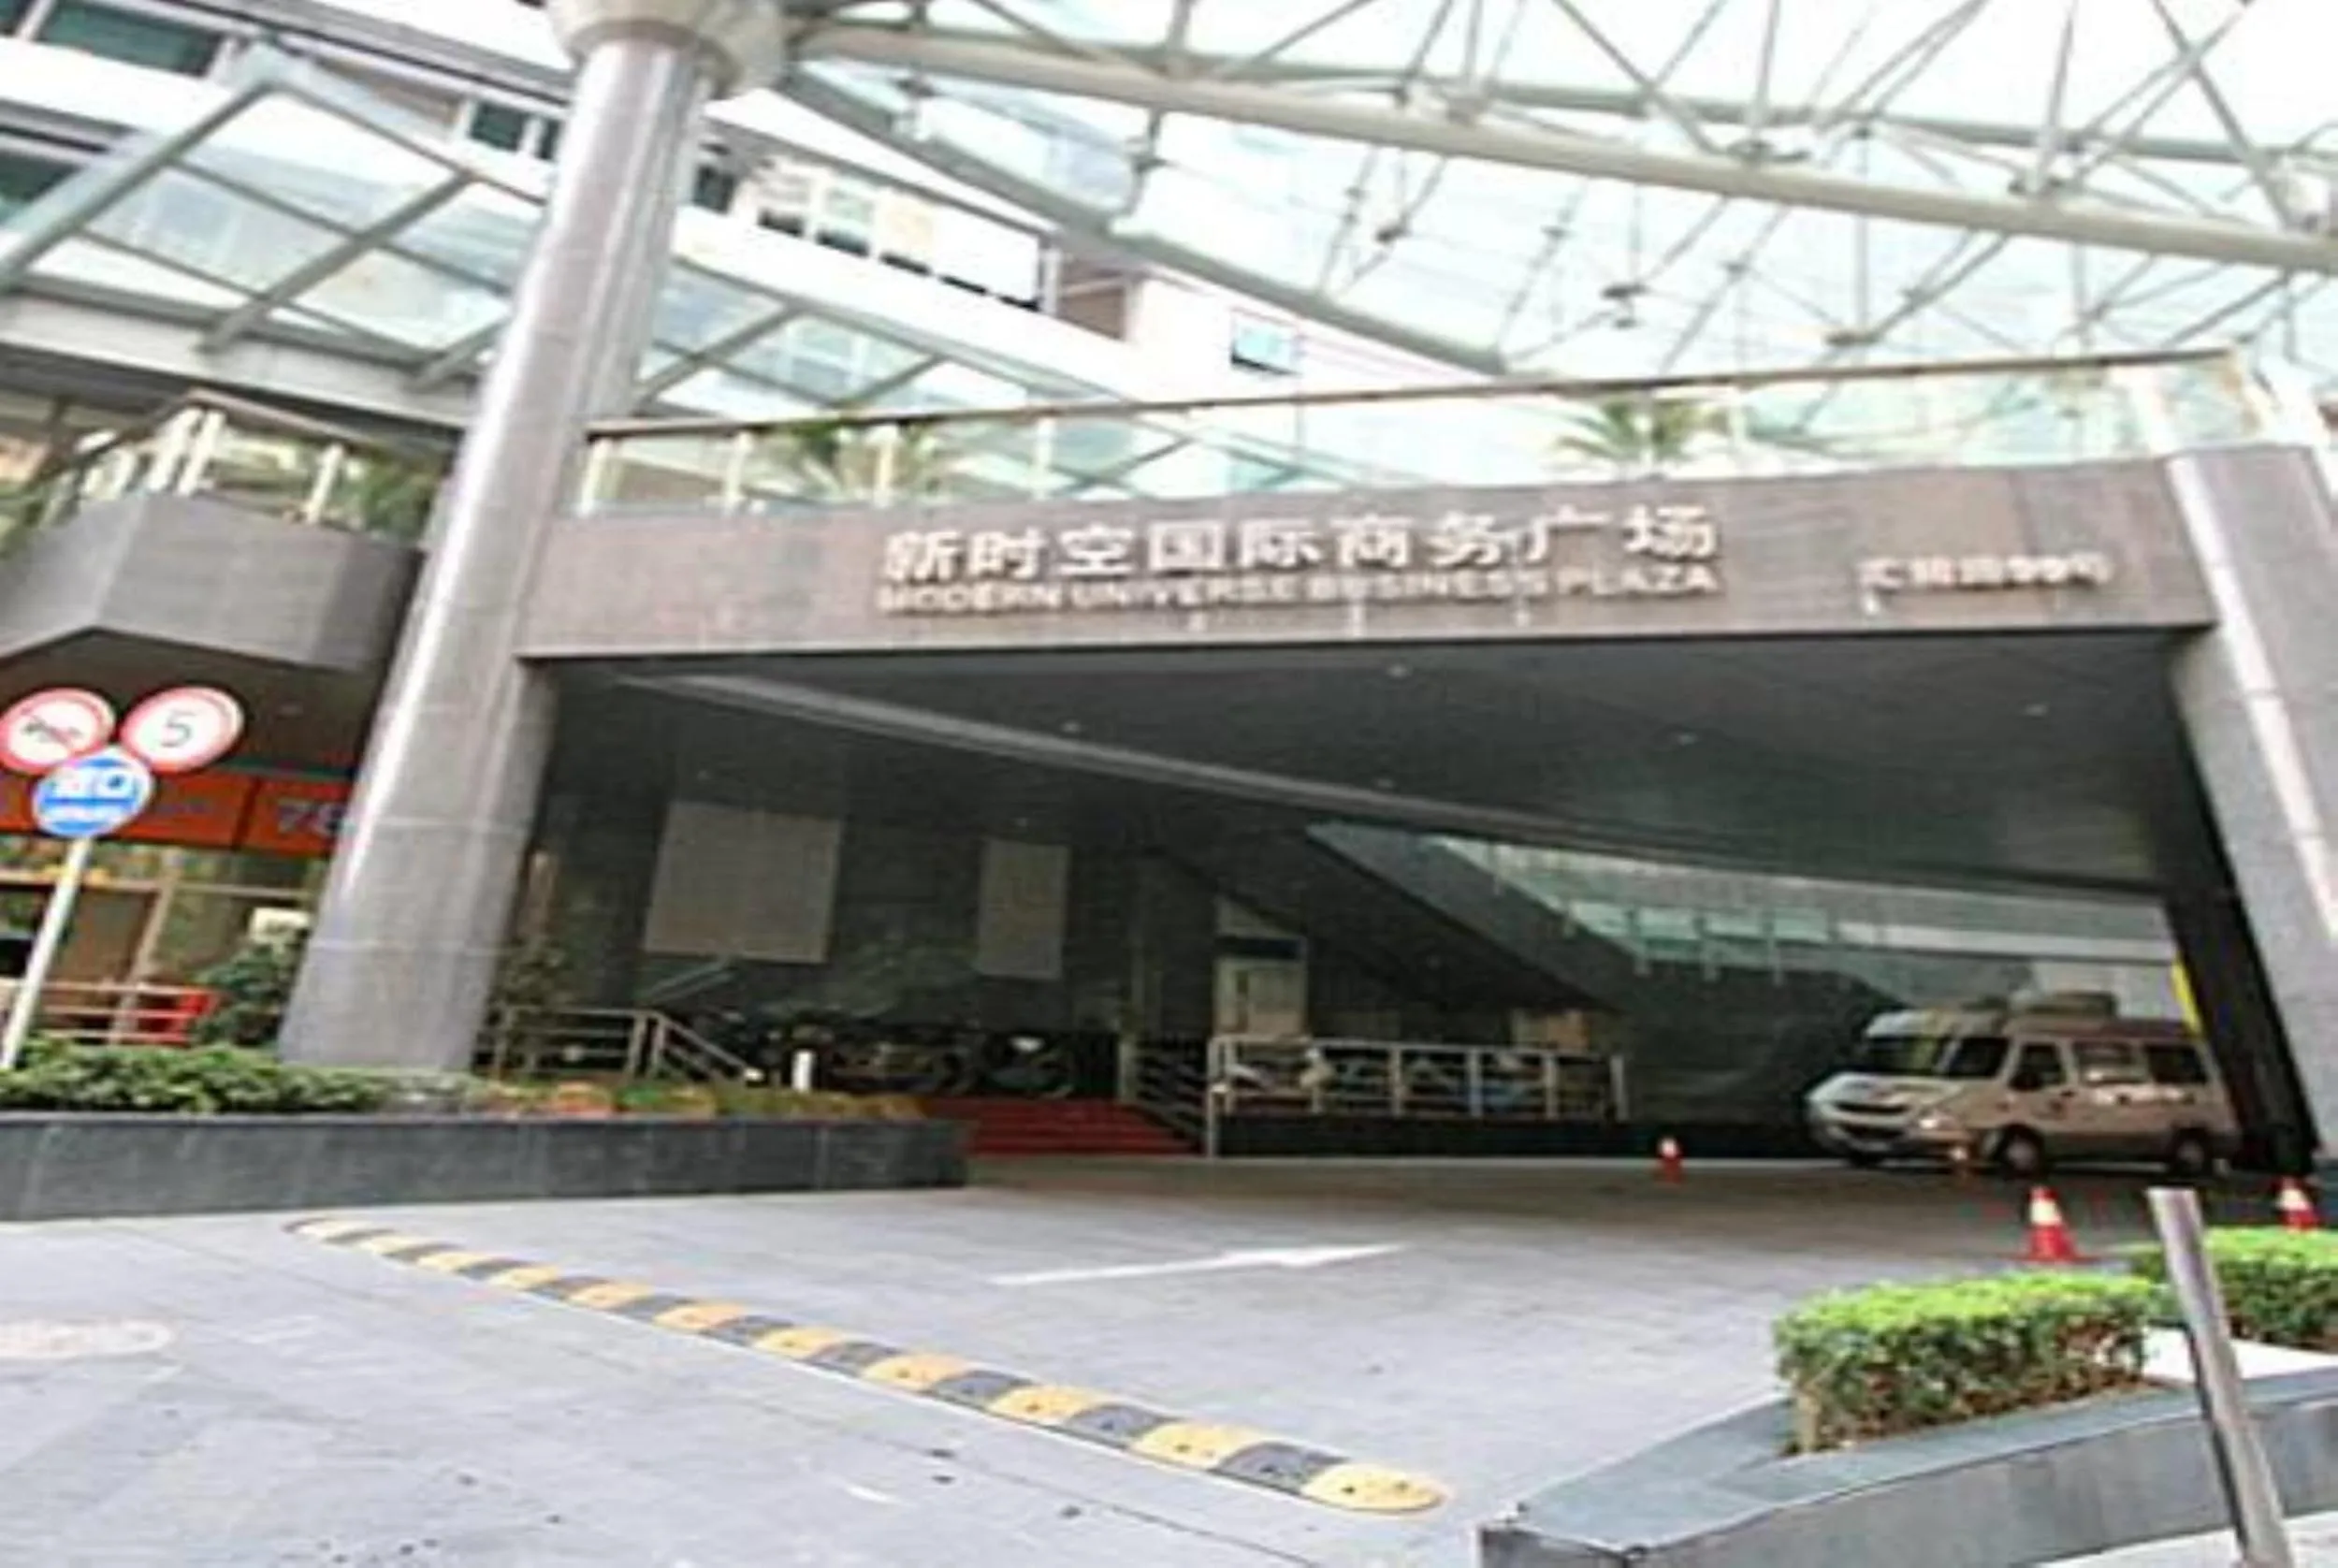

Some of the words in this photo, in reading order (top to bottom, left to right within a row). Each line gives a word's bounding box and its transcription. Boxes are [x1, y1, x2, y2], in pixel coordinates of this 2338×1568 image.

[884, 503, 1719, 583] 新时空国际商务广场
[878, 581, 1063, 613] MODERN
[1558, 563, 1721, 597] PLAZA
[161, 708, 196, 748] 5
